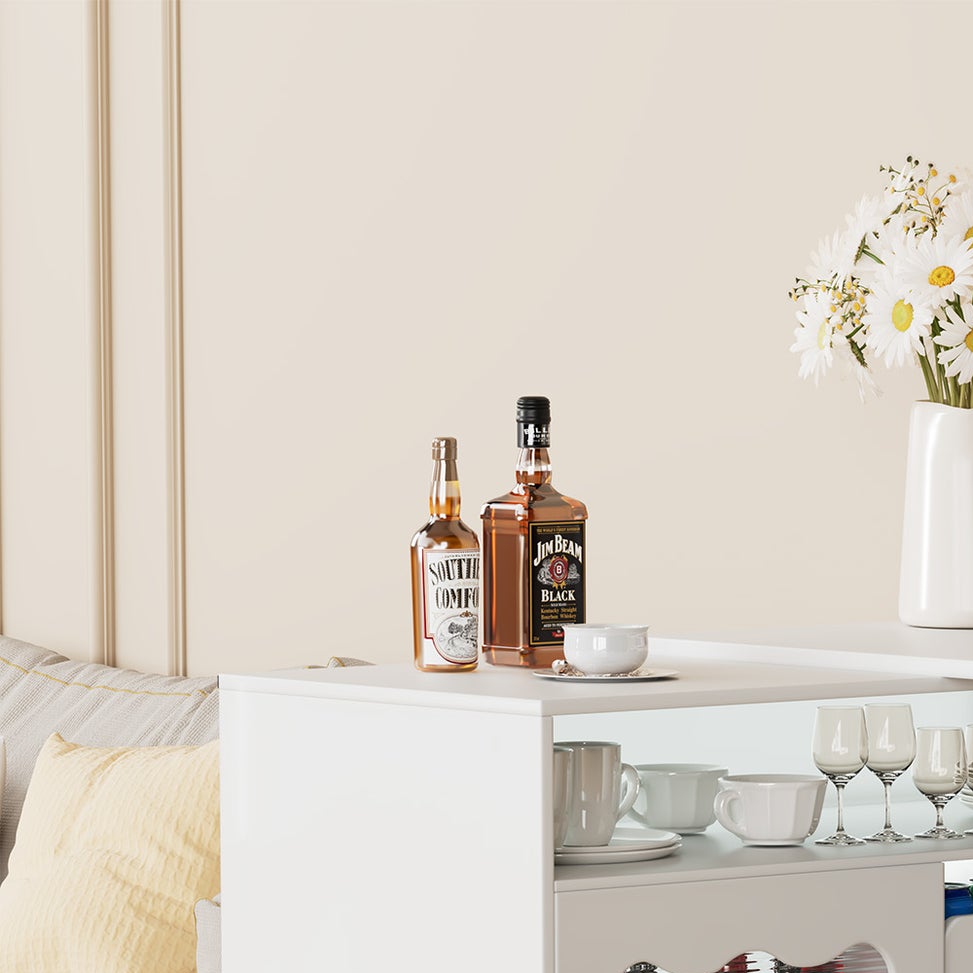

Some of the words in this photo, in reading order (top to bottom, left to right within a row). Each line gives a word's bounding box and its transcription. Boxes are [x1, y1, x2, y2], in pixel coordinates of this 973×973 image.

[533, 539, 554, 567] JIM
[554, 534, 583, 564] BEAM
[428, 557, 480, 586] SOUTH
[541, 589, 576, 602] BLACK
